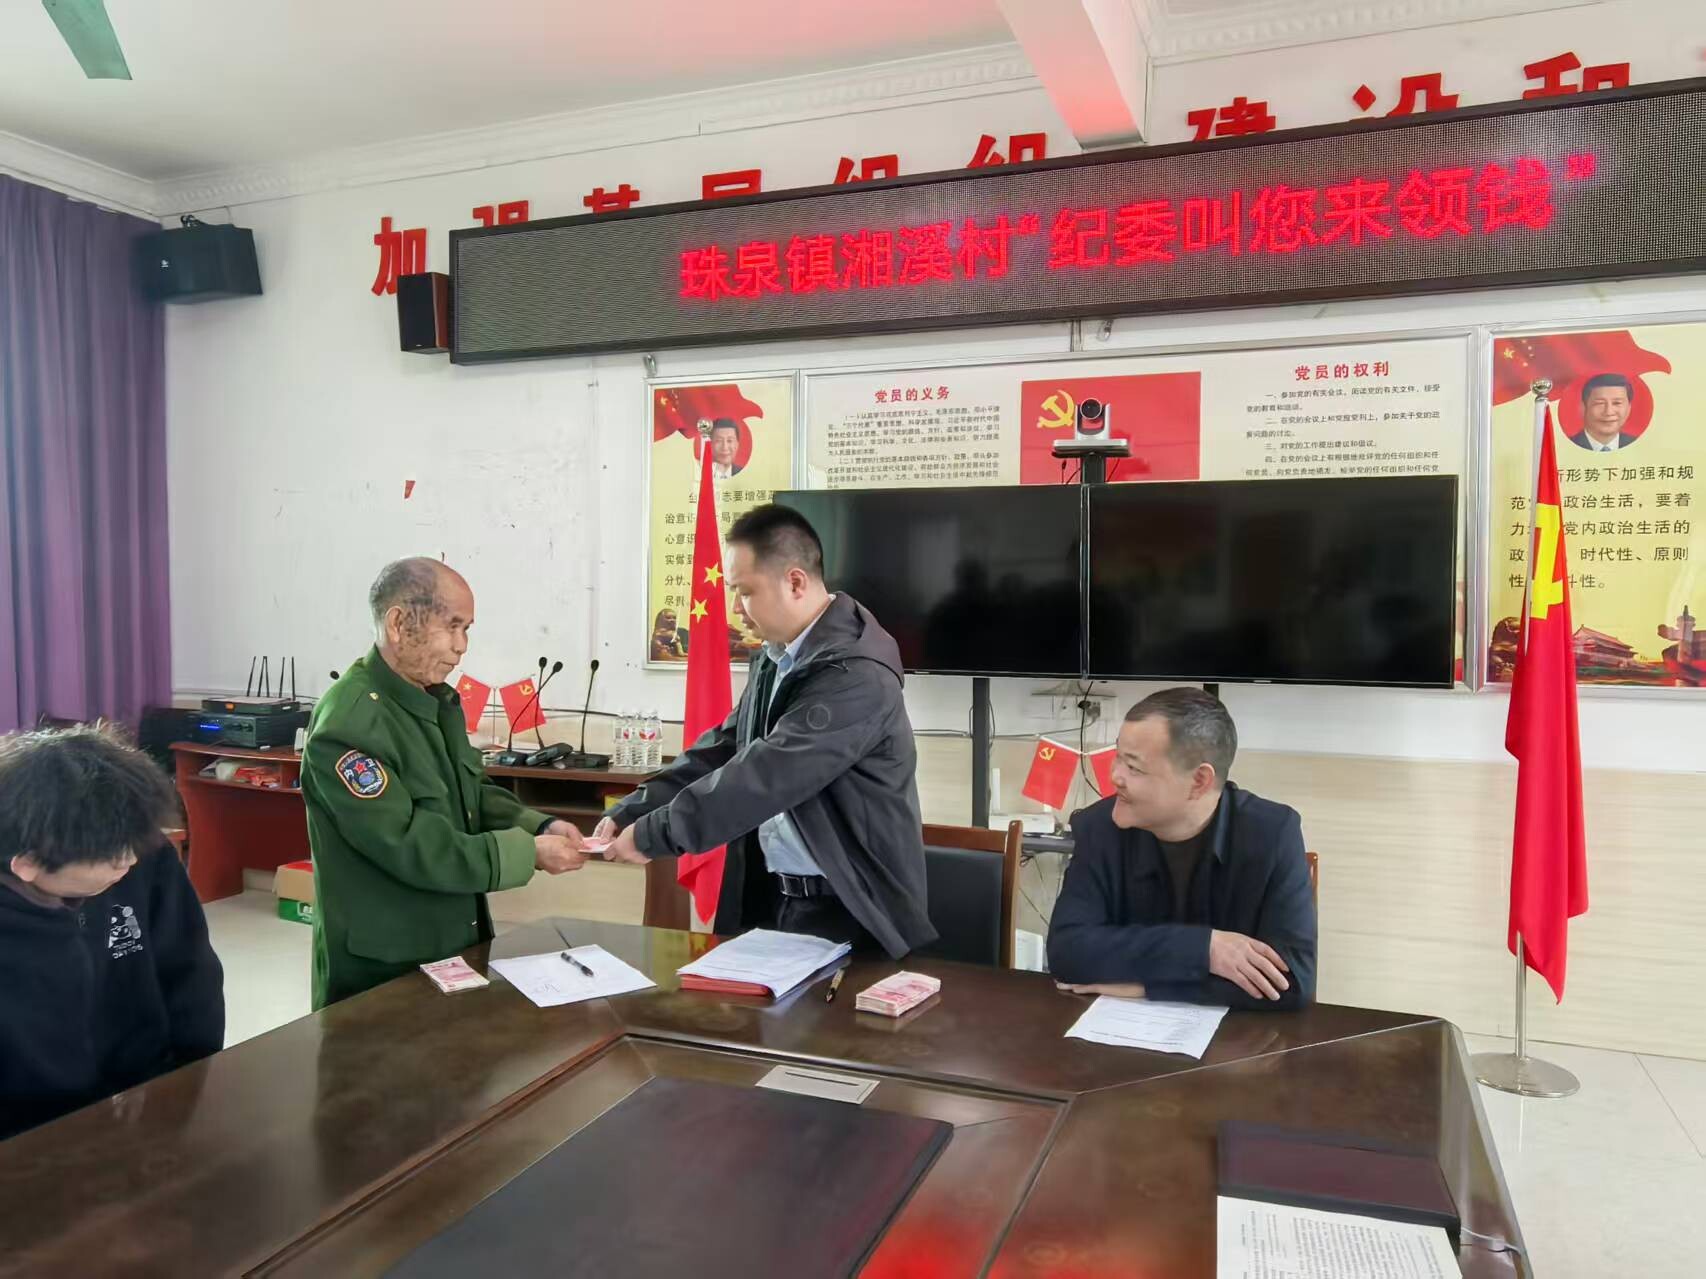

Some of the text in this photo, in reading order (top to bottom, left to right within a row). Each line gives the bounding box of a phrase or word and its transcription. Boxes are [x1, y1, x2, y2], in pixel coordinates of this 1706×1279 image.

[1295, 361, 1390, 381] 党员的权利
[875, 386, 950, 403] 党员的义务
[1511, 492, 1691, 510] 范政治生活，要着
[1510, 519, 1690, 536] 力党内政治生活的
